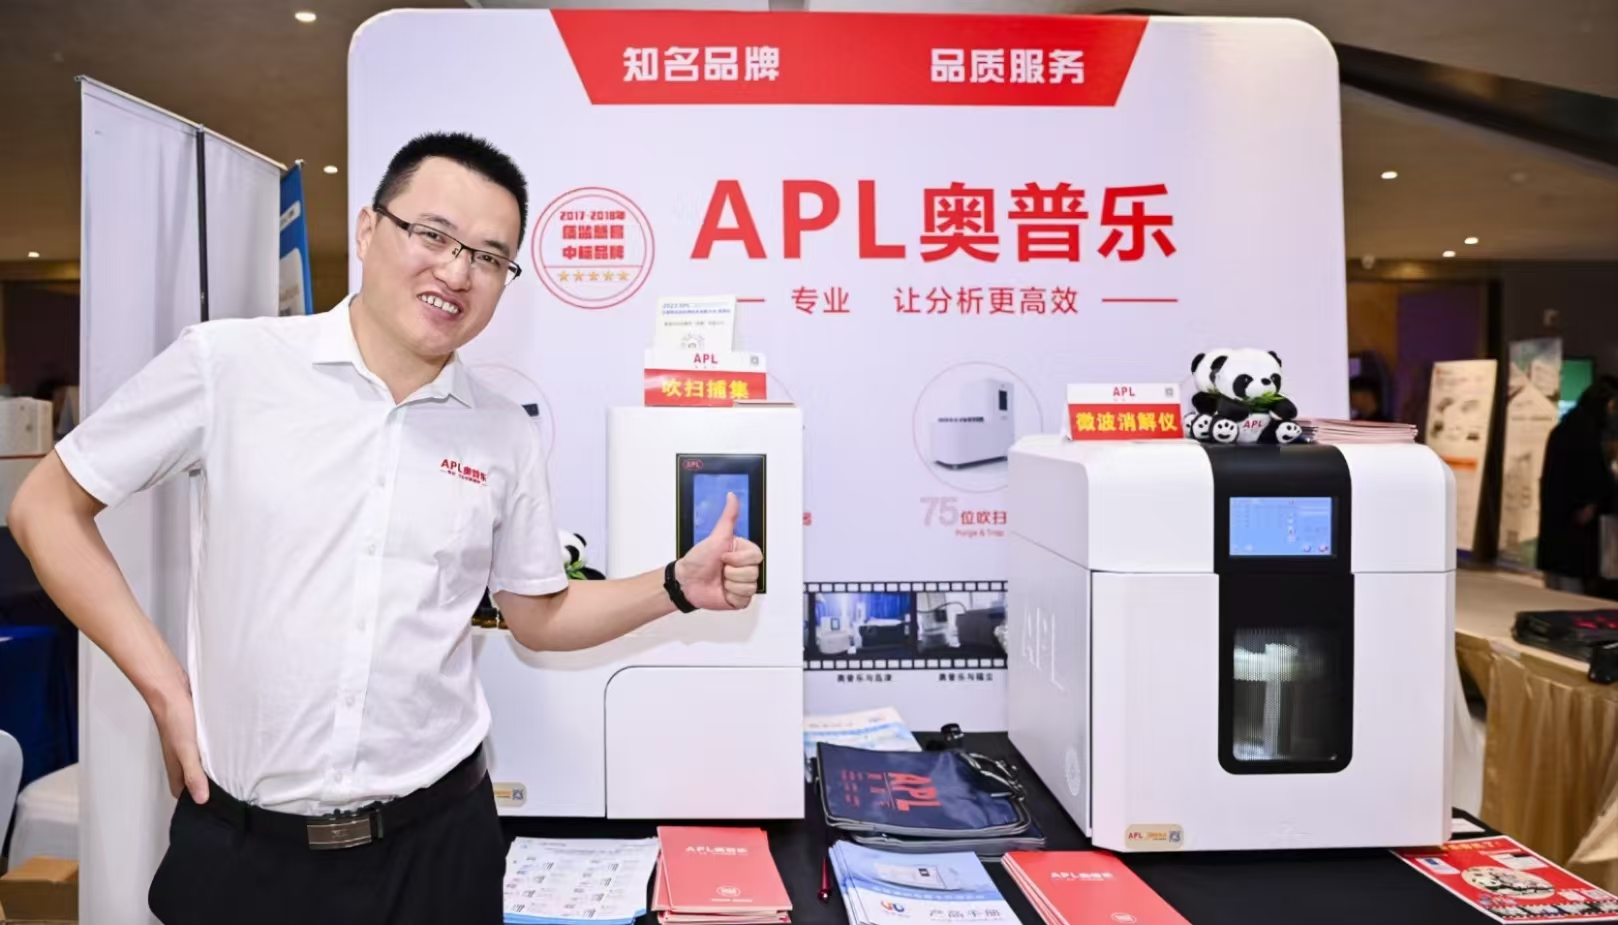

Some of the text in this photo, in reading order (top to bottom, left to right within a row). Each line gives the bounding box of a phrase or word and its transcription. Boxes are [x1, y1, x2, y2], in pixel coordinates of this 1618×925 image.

[622, 45, 780, 83] 知名品牌
[930, 48, 1085, 84] 品质服务
[689, 178, 1178, 265] APL奥普乐
[791, 286, 1079, 316] 专业 让分析更高效
[693, 353, 718, 365] APL
[661, 378, 750, 399] 吹扫捕集
[1112, 386, 1135, 398] APL
[1075, 411, 1179, 433] 微波消解仪
[1242, 419, 1264, 430] APL
[887, 771, 942, 812] APL
